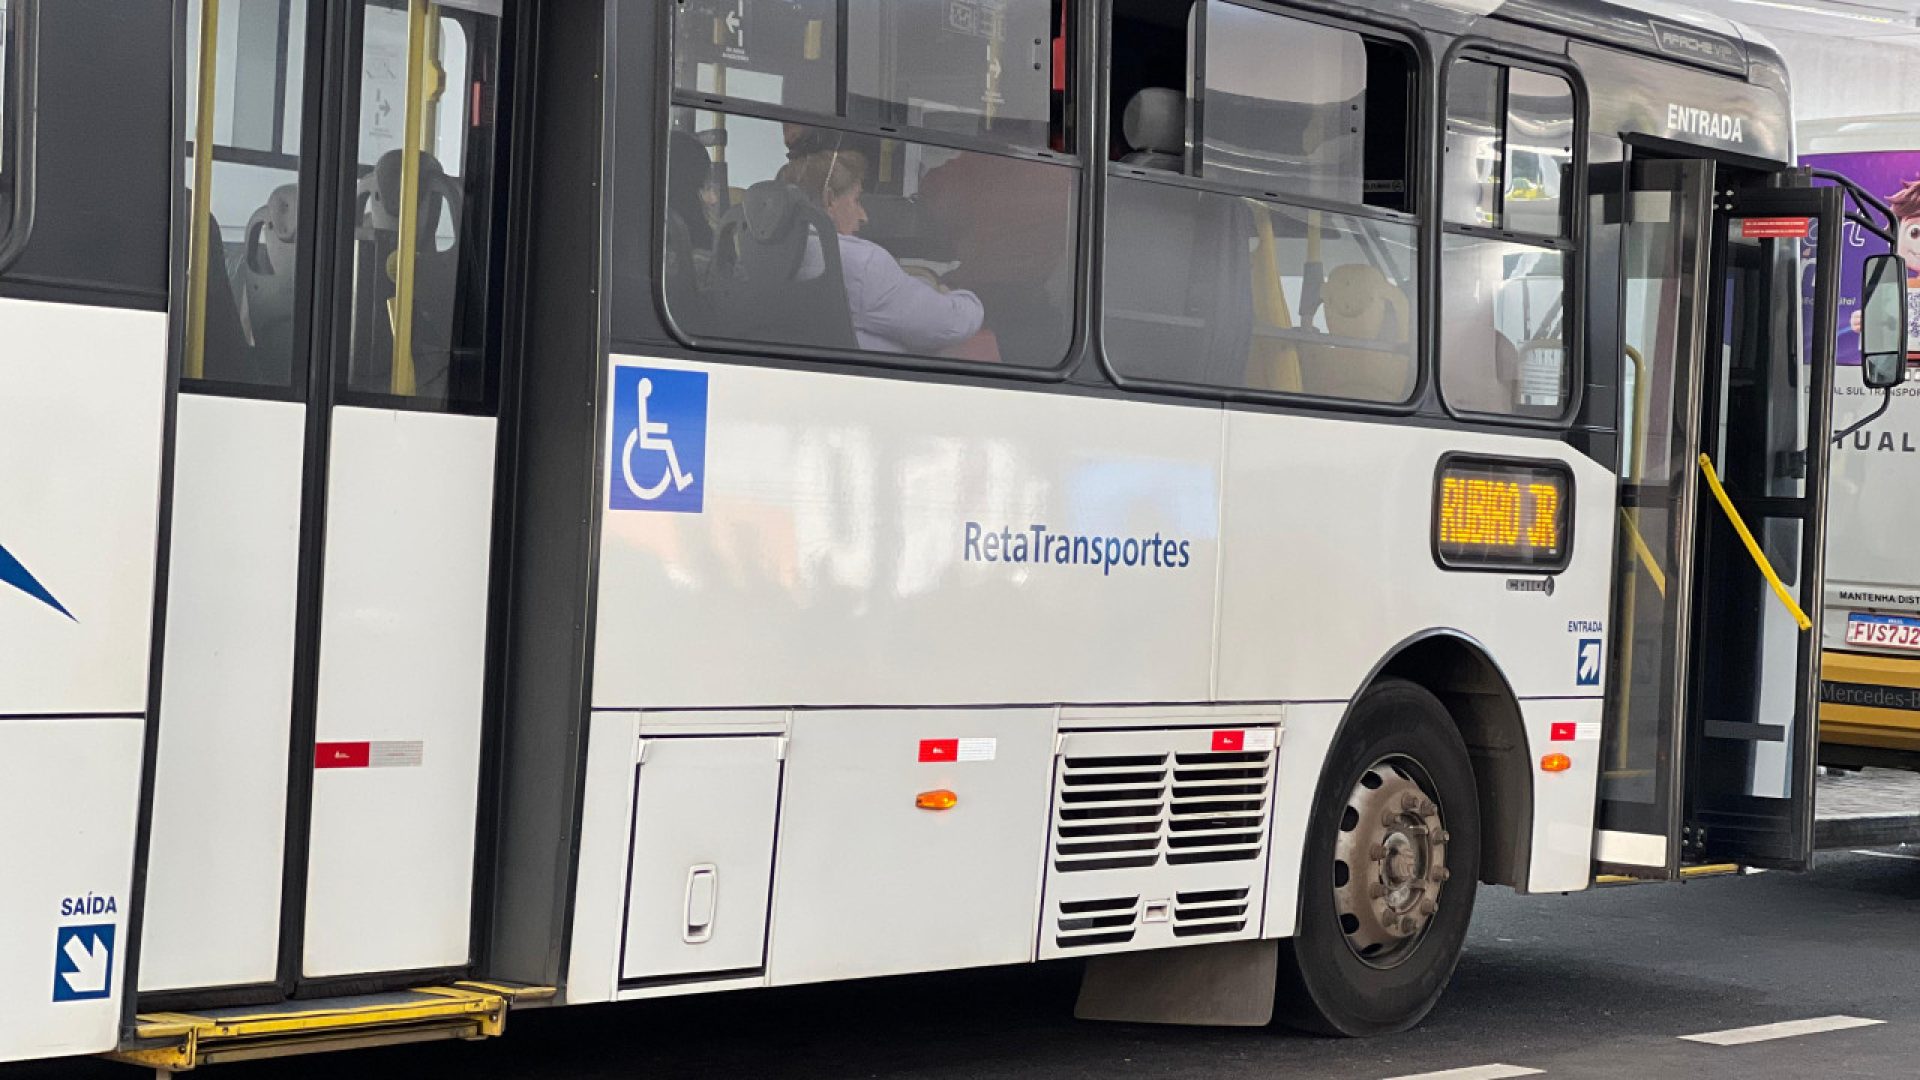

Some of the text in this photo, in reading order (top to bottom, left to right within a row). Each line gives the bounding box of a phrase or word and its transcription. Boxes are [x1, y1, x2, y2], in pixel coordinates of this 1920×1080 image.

[1667, 103, 1743, 142] ENTRADA
[964, 521, 1190, 576] RetaTransportes
[1840, 590, 1896, 604] MANTENHA
[1568, 620, 1603, 633] ENTRADA
[1854, 622, 1920, 646] FVS7J2
[61, 890, 117, 916] SAÍDA
